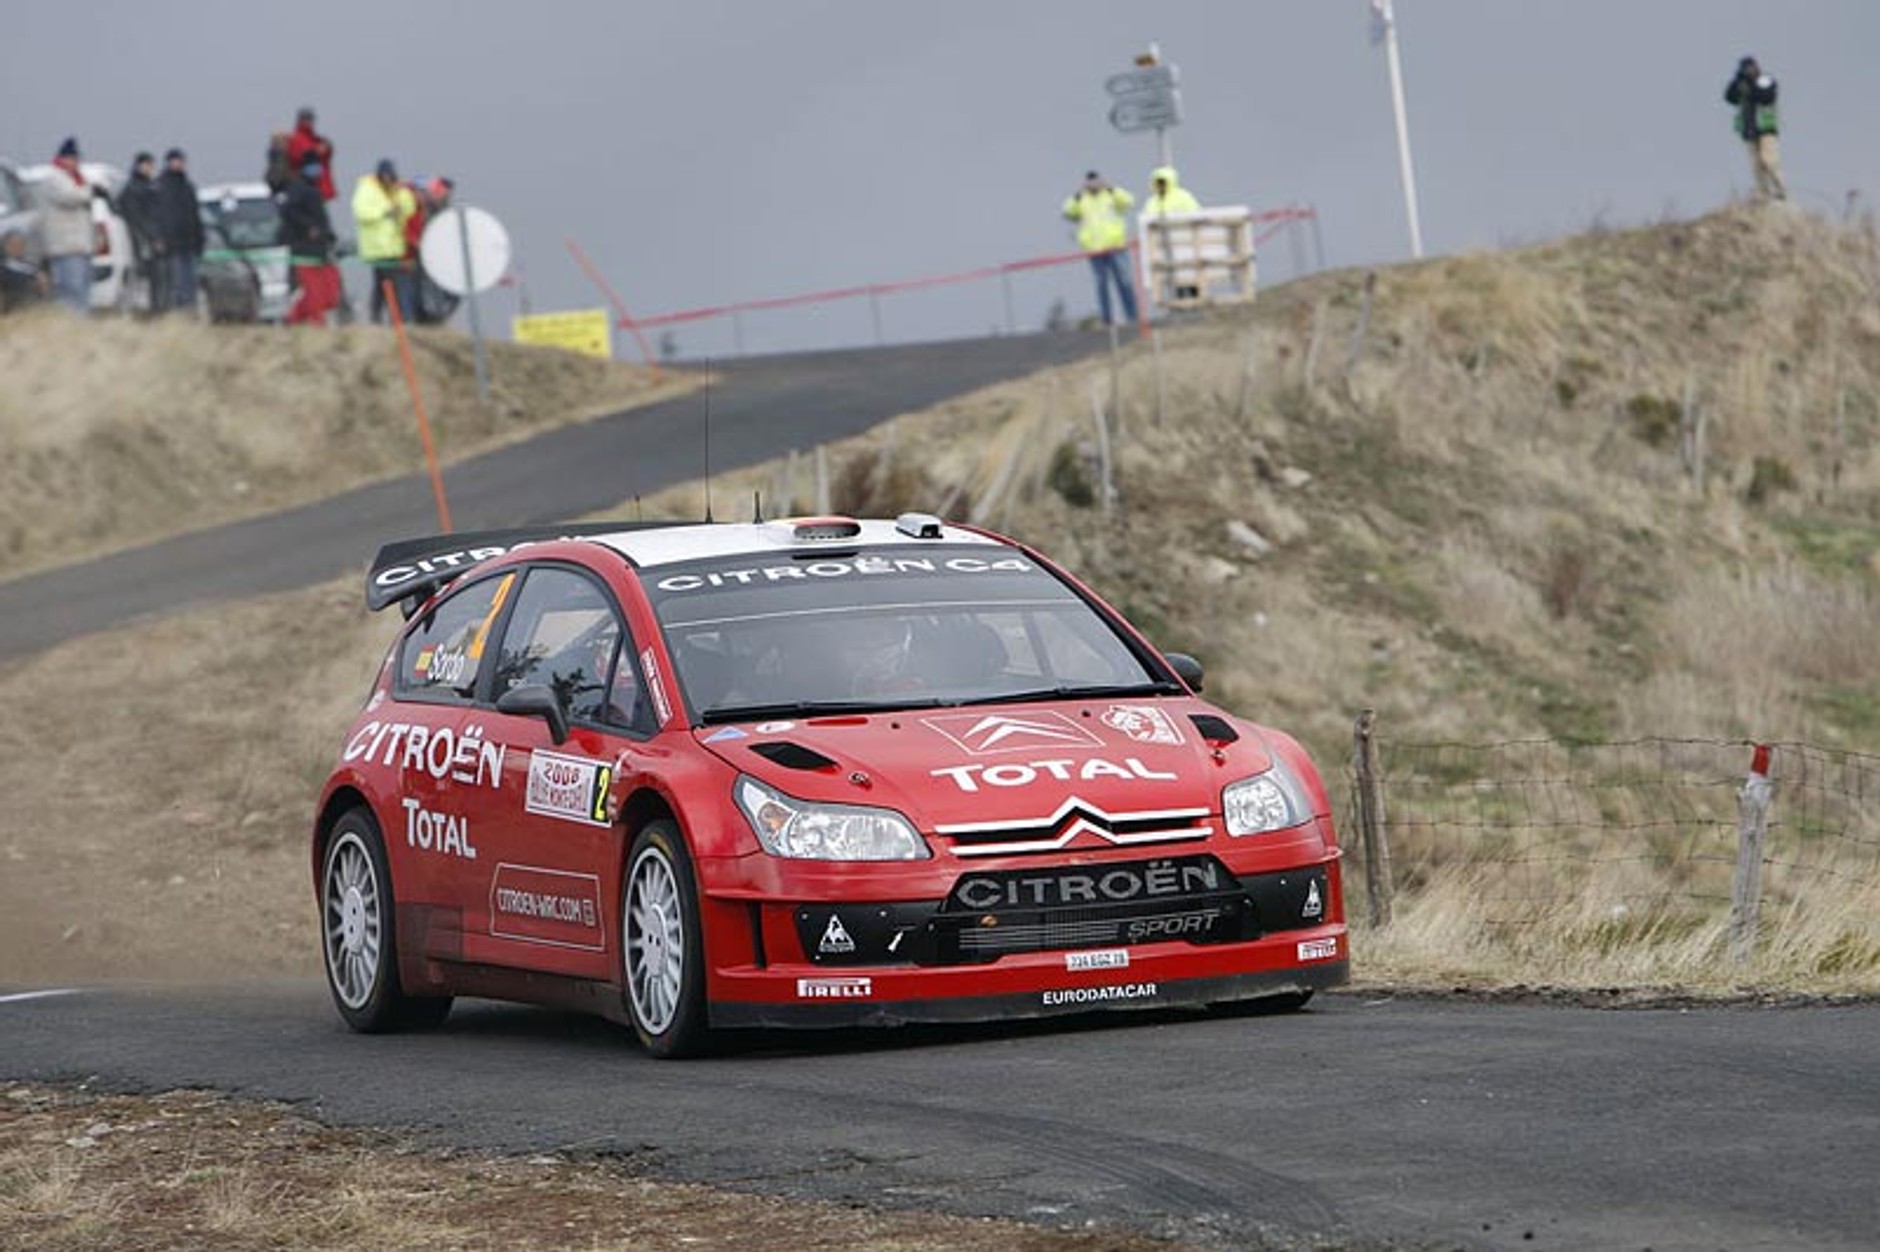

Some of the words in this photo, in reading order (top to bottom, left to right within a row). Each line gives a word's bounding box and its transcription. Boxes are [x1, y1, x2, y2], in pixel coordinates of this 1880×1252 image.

[658, 556, 935, 592] CITROËN
[946, 557, 1034, 574] C4
[343, 720, 507, 789] CITROËN
[930, 758, 1179, 791] TOTAL
[594, 767, 610, 821] 2
[402, 798, 477, 859] TOTAL
[957, 860, 1219, 908] CITROËN
[1127, 911, 1219, 938] SPORT
[797, 977, 872, 998] PIRELLI
[1043, 983, 1157, 1005] EURODATACAR
